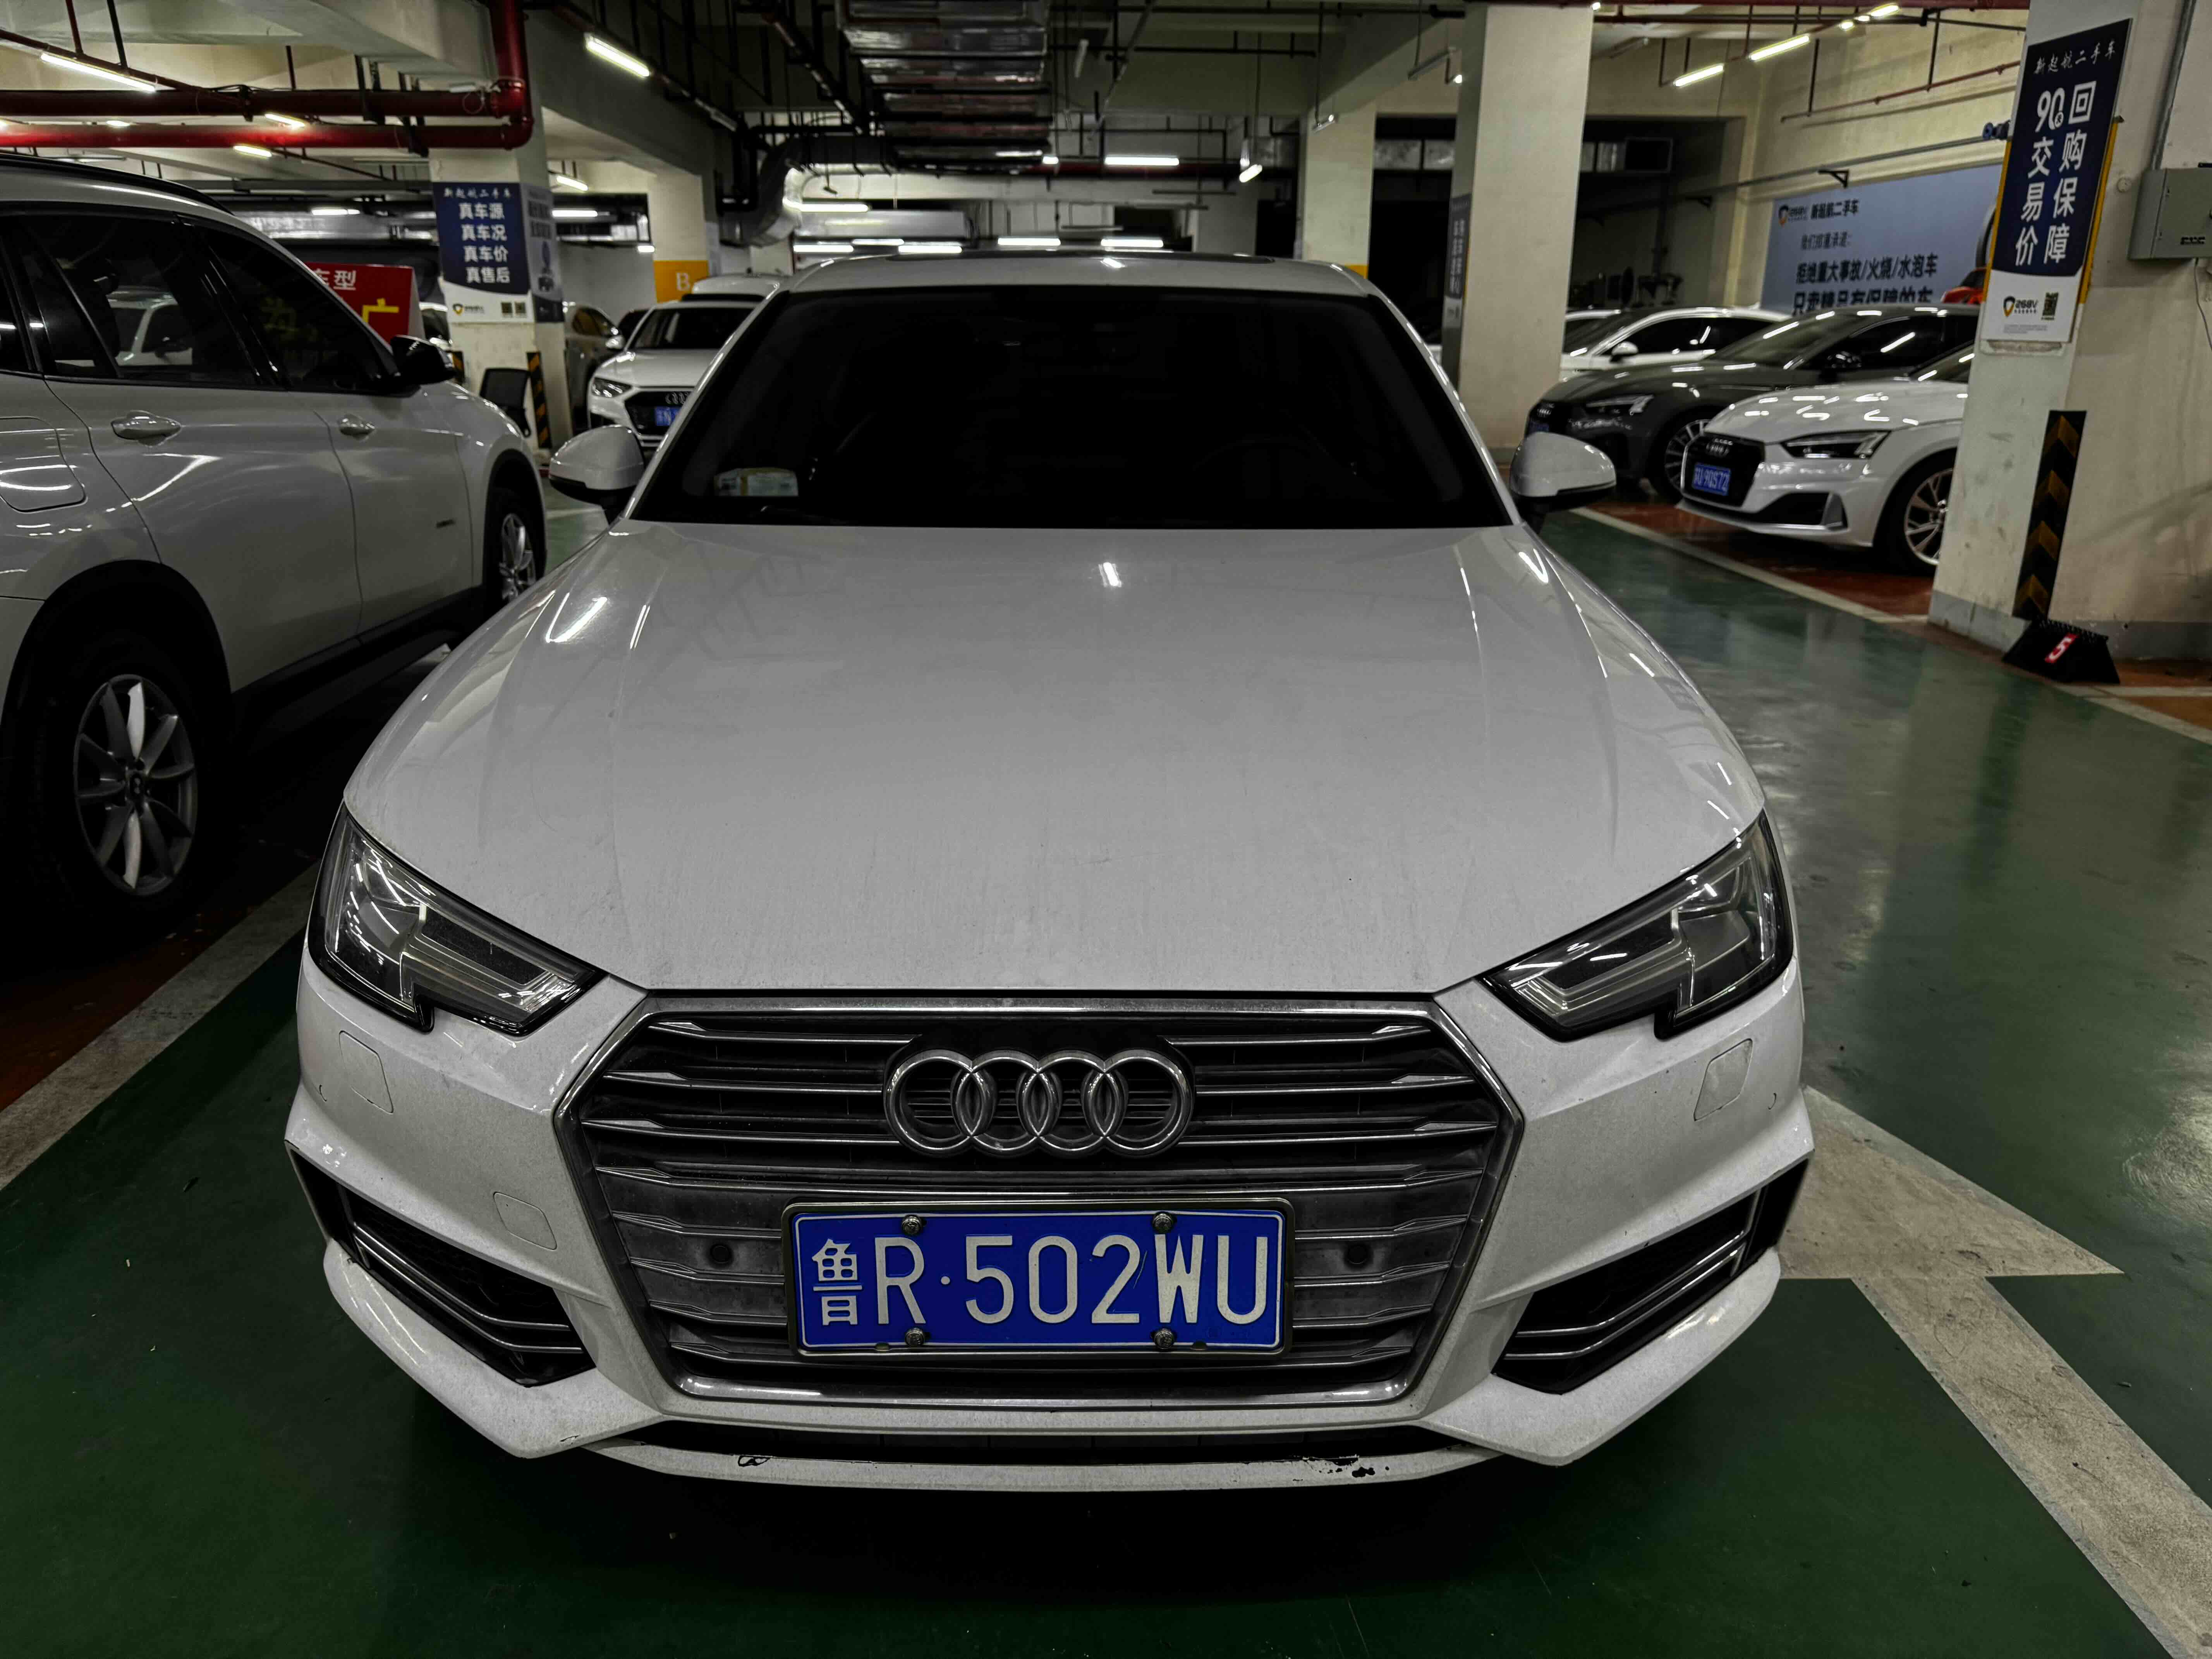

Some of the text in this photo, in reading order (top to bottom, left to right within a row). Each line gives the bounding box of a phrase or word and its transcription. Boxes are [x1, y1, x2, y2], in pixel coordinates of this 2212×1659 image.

[2044, 80, 2097, 264] 回购保障
[459, 202, 505, 220] 真车源
[461, 224, 507, 241] 真车况
[463, 245, 508, 263] 真车价
[466, 267, 510, 283] 真售后
[676, 272, 690, 291] B
[812, 1234, 1268, 1325] 鲁R·502WU
